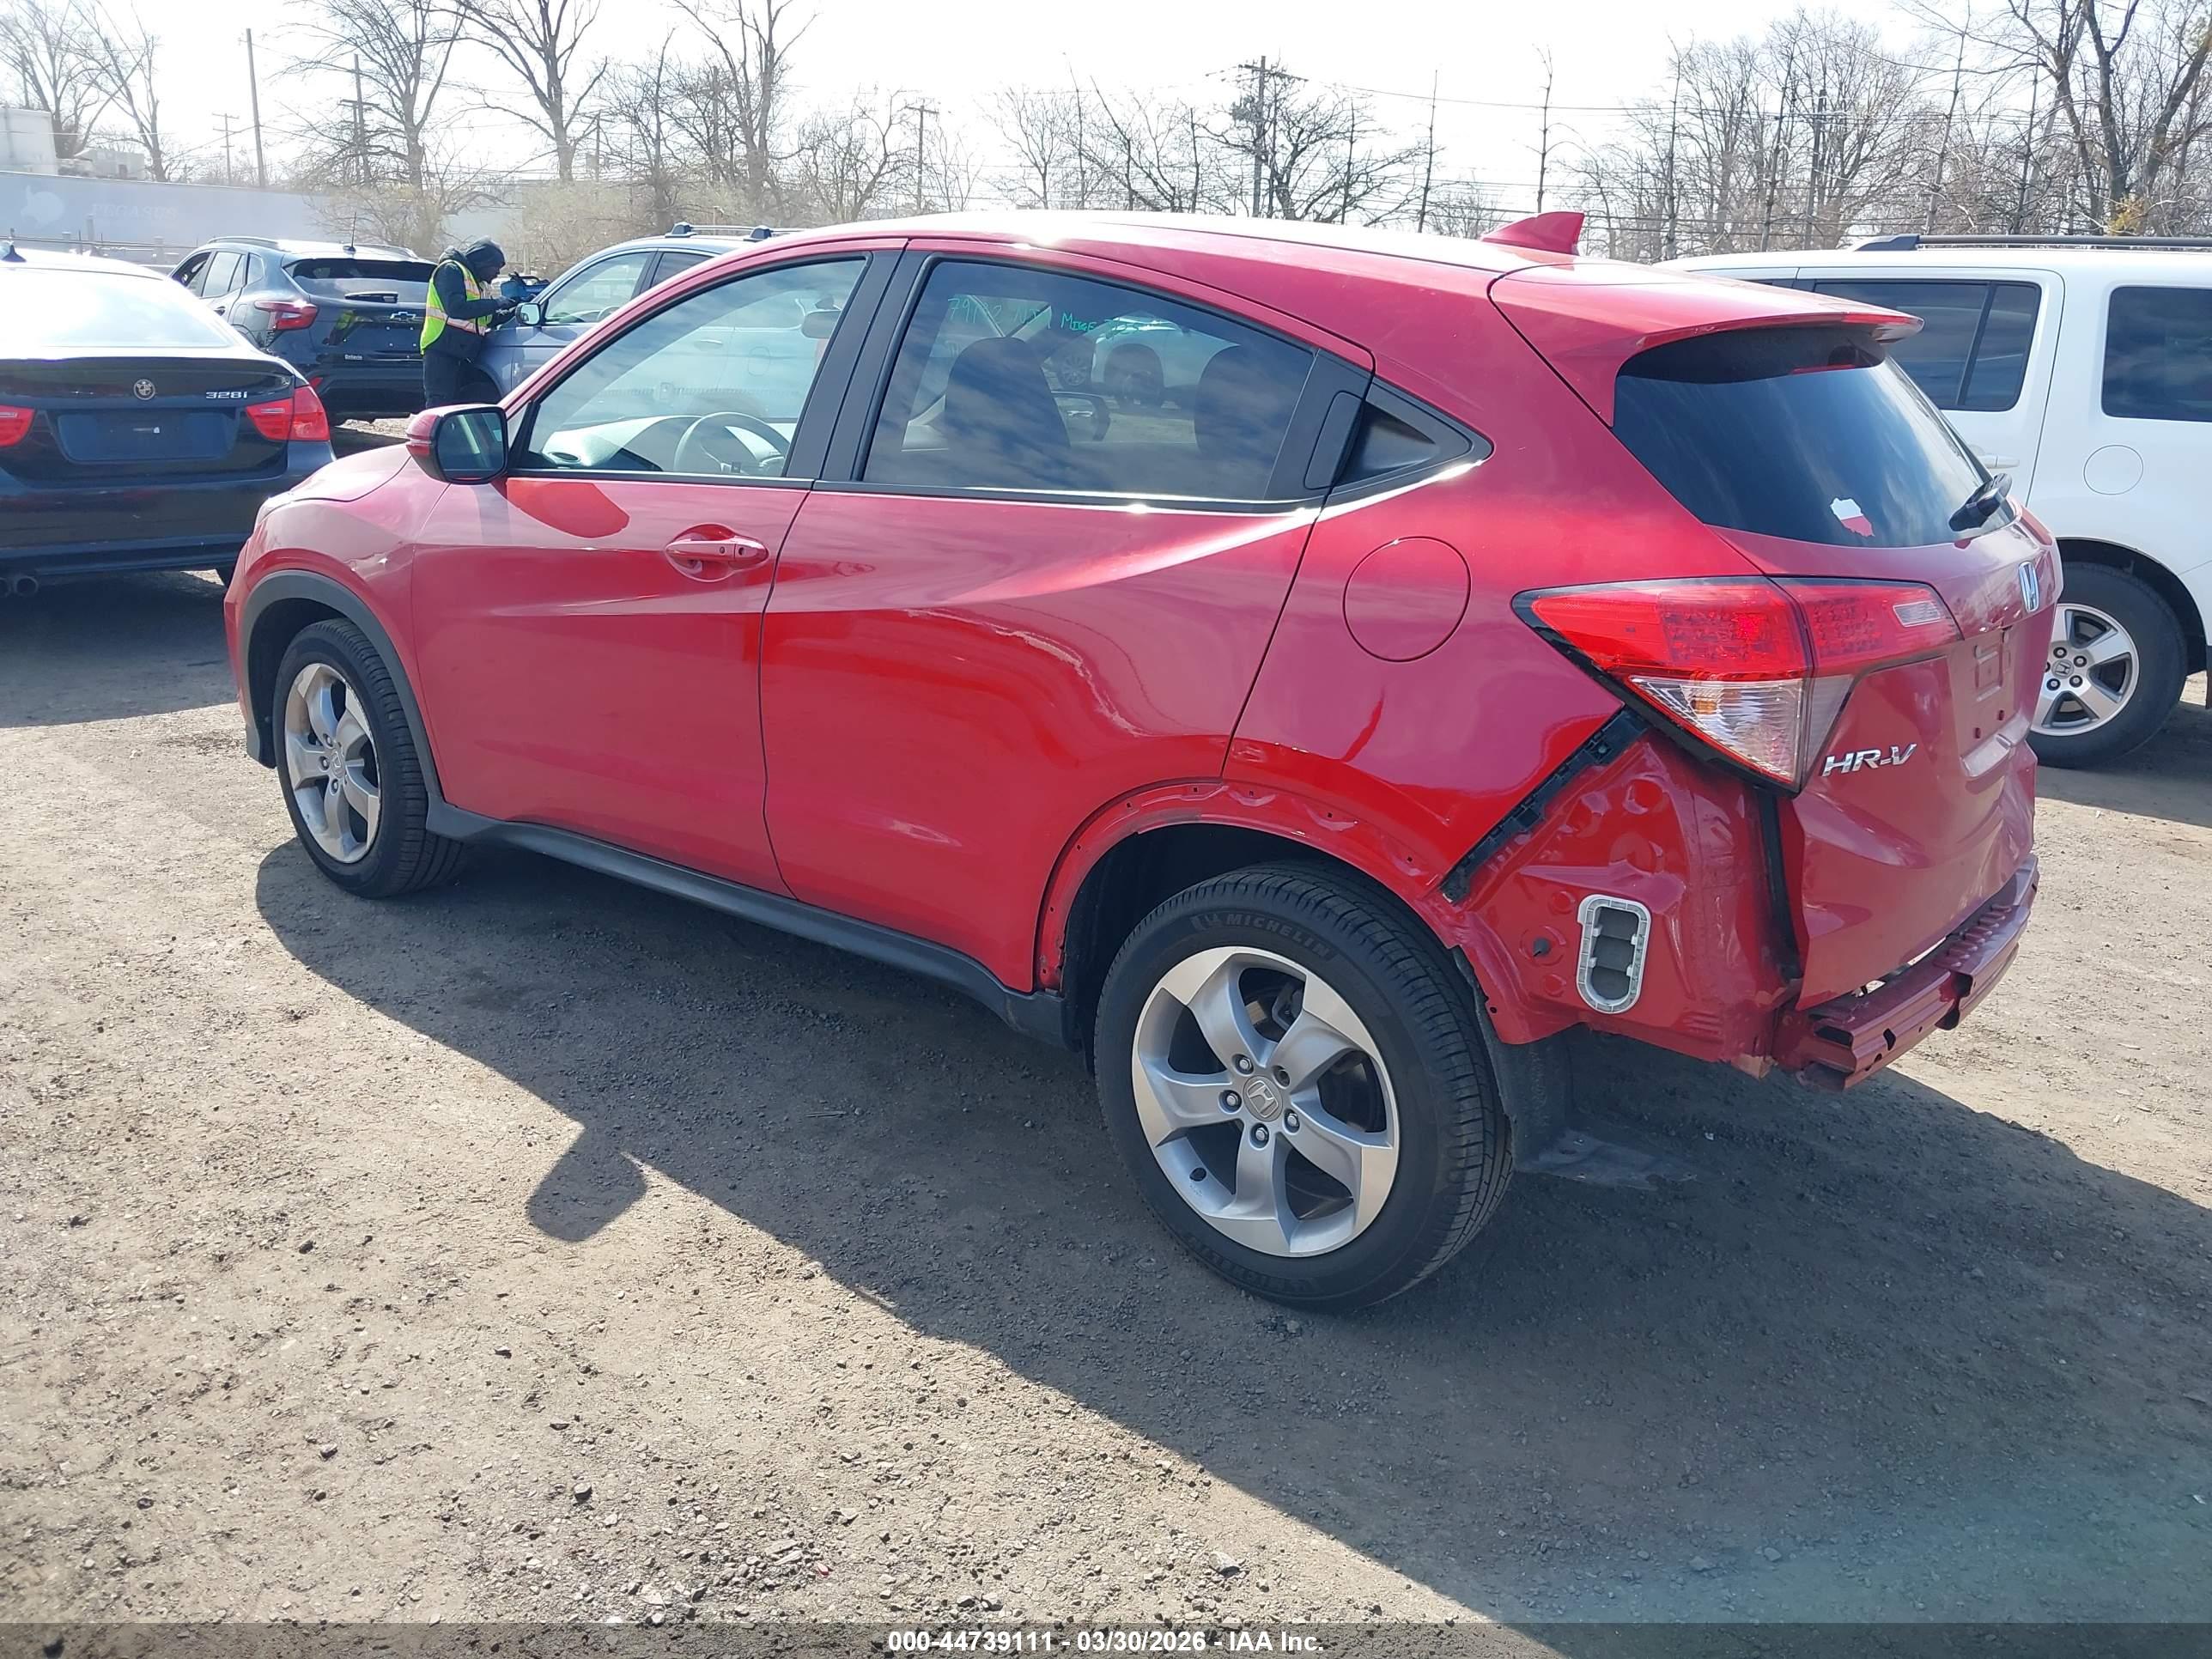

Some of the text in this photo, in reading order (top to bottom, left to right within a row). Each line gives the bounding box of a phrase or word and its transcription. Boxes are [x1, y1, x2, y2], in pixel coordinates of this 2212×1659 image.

[205, 391, 248, 399] 328i
[1821, 743, 1917, 777] HR-V
[1225, 913, 1332, 960] MICHELIN
